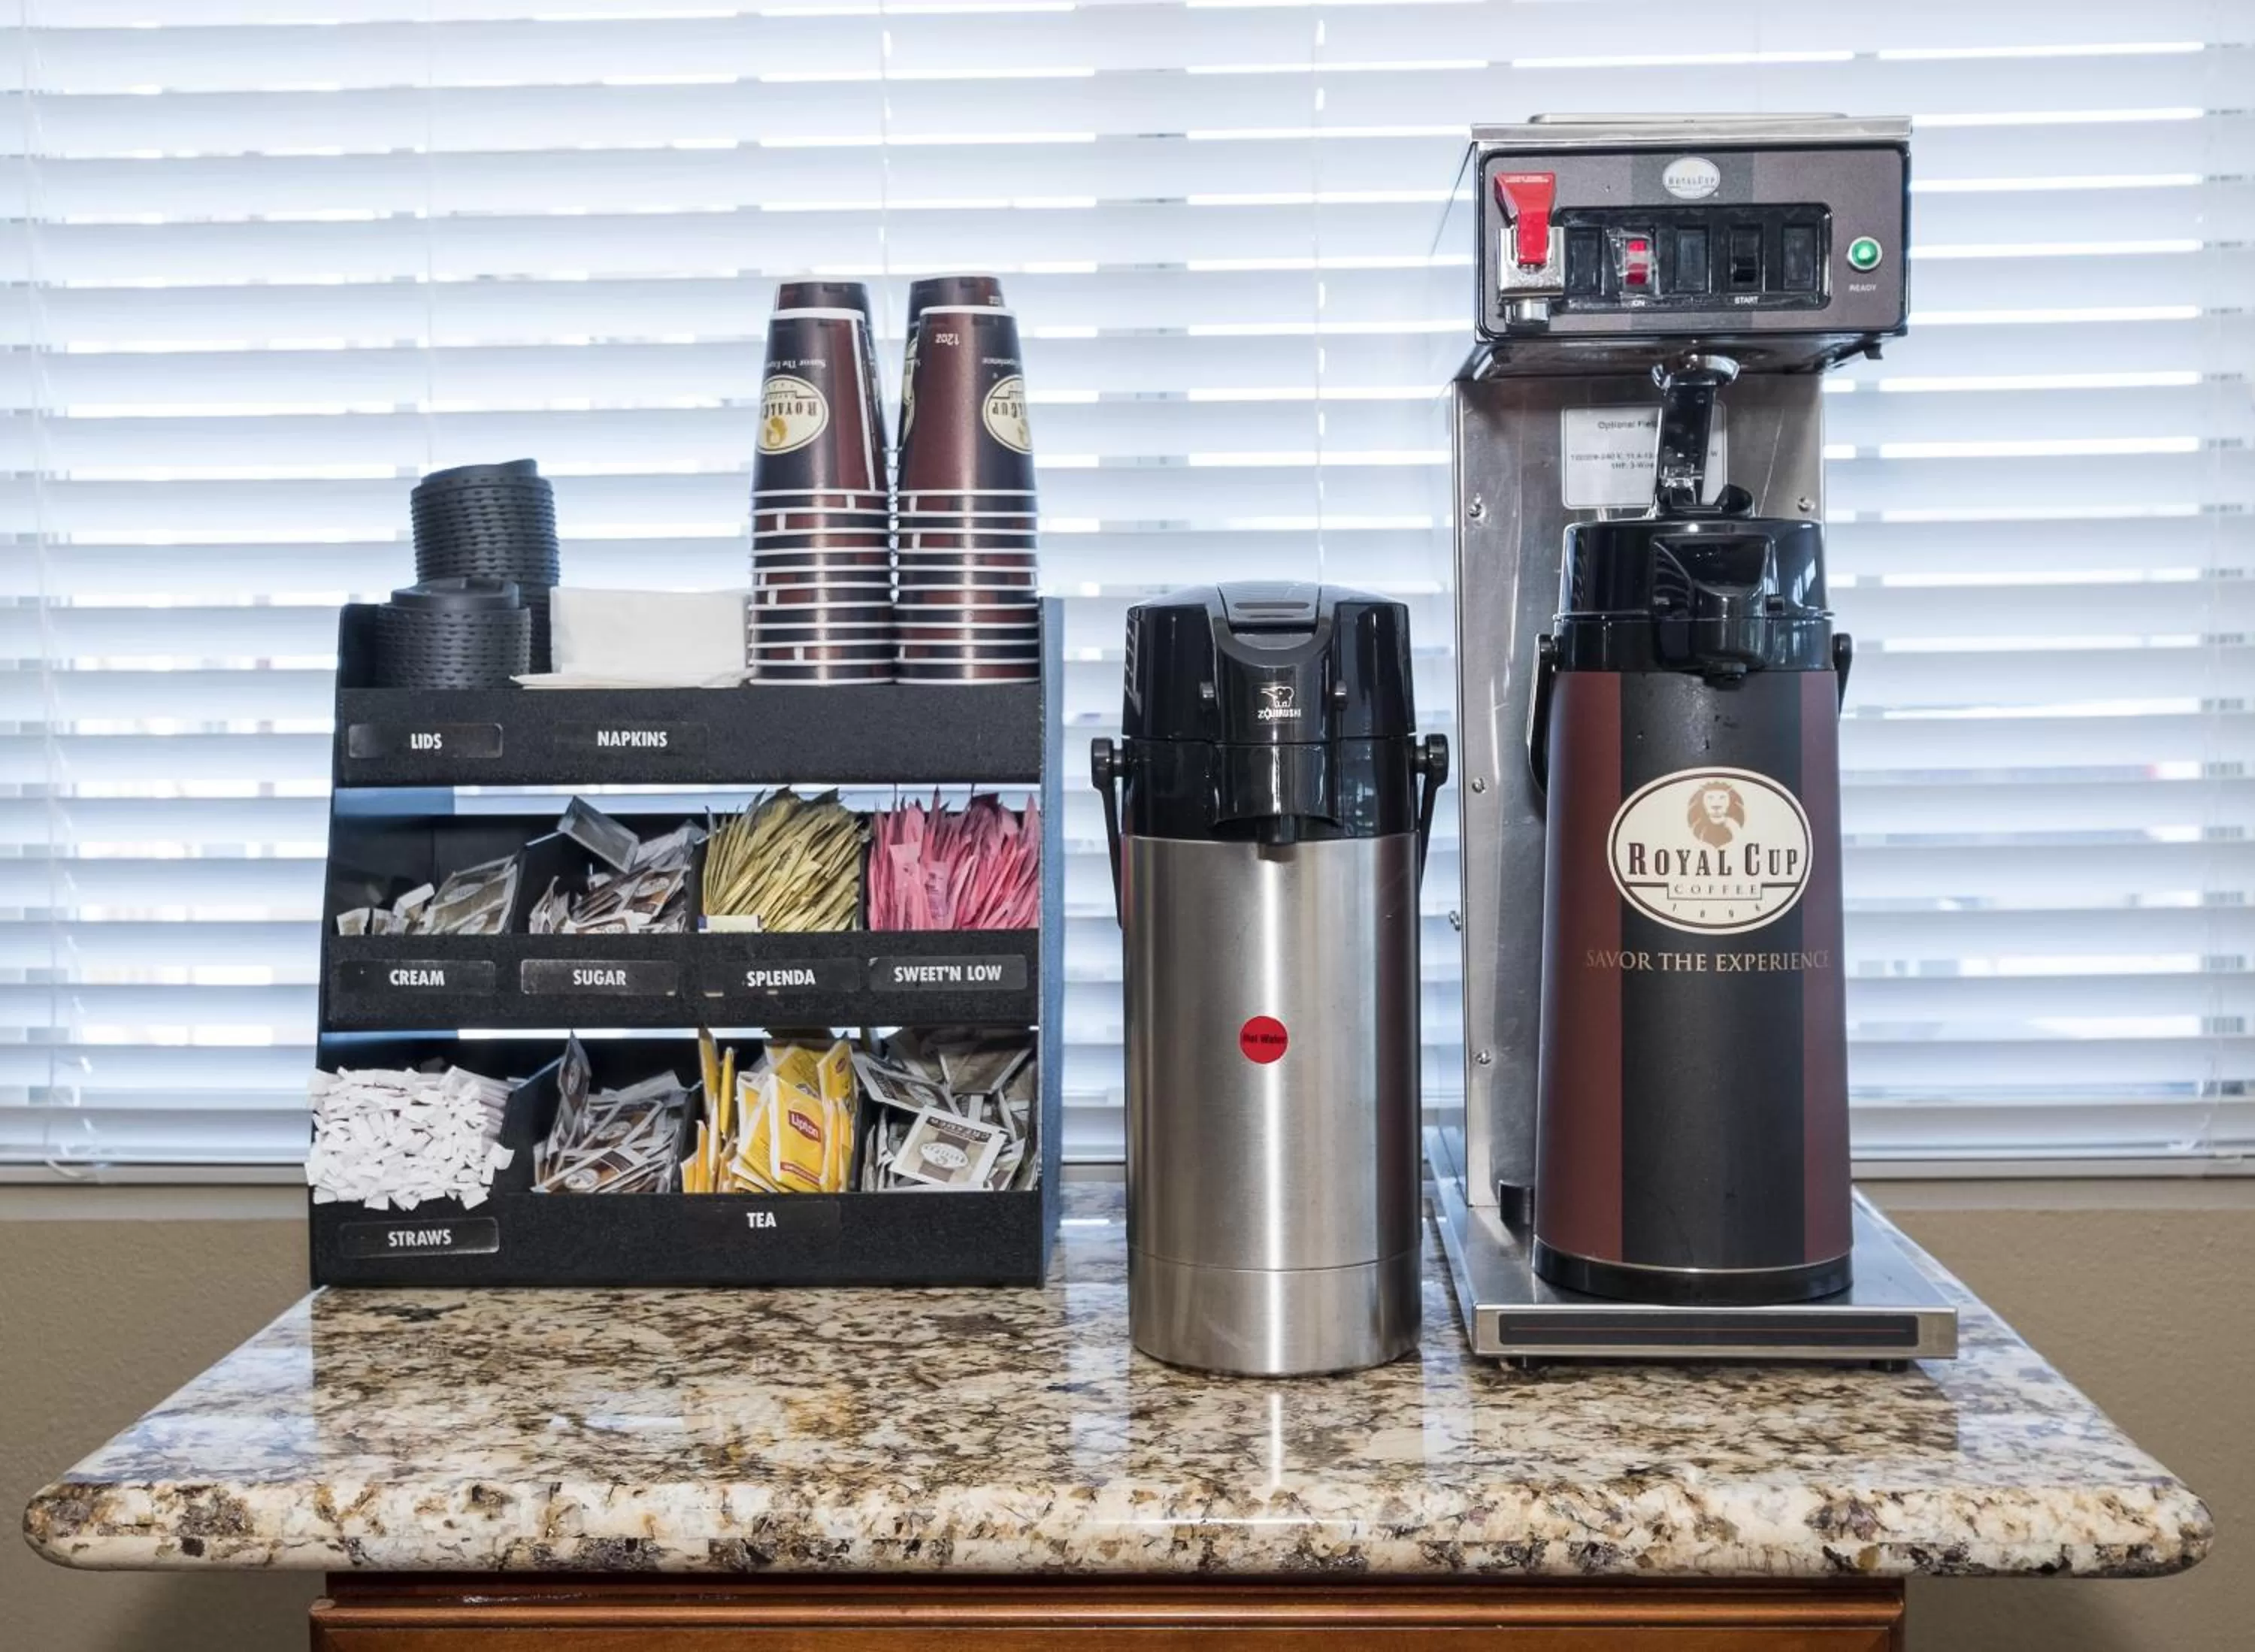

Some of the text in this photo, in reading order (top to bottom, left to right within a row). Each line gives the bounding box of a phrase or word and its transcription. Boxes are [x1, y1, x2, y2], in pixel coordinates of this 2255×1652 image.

[1849, 283, 1877, 292] READY
[1734, 295, 1759, 304] START
[934, 333, 961, 345] 12oz
[1597, 420, 1636, 431] Optional
[410, 733, 443, 750] LIDS
[597, 731, 667, 748] NAPKINS
[1627, 842, 1798, 876] ROYAL CUP
[1674, 883, 1757, 895] COFFEE
[1586, 949, 1830, 972] SAVOR THE EXPERIENCE
[389, 970, 445, 987] CREAM
[573, 970, 627, 986] SUGAR
[746, 969, 816, 987] SPLENDA
[894, 965, 1002, 982] SWEET'N LOW
[1260, 1033, 1286, 1044] Water
[791, 1112, 819, 1139] Lipton
[746, 1212, 776, 1228] TEA
[388, 1229, 453, 1248] STRAWS
